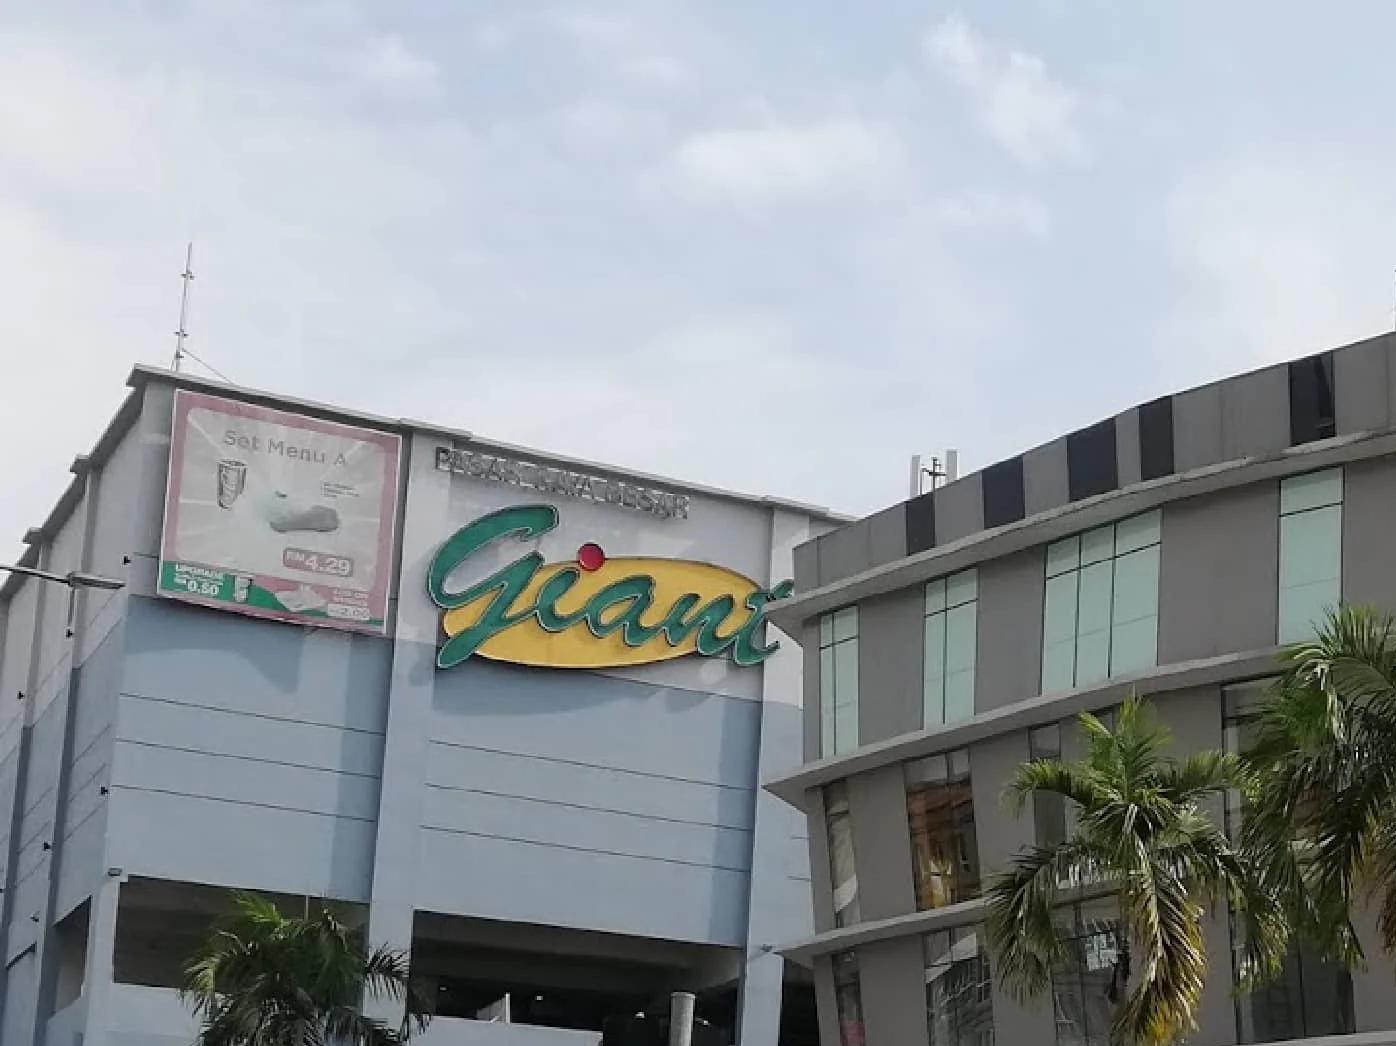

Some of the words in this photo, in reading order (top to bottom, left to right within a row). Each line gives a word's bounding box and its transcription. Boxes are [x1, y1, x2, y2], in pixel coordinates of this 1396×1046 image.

[223, 429, 259, 451] Set
[267, 437, 326, 464] Menu
[333, 451, 348, 466] A
[304, 553, 351, 576] 4.29
